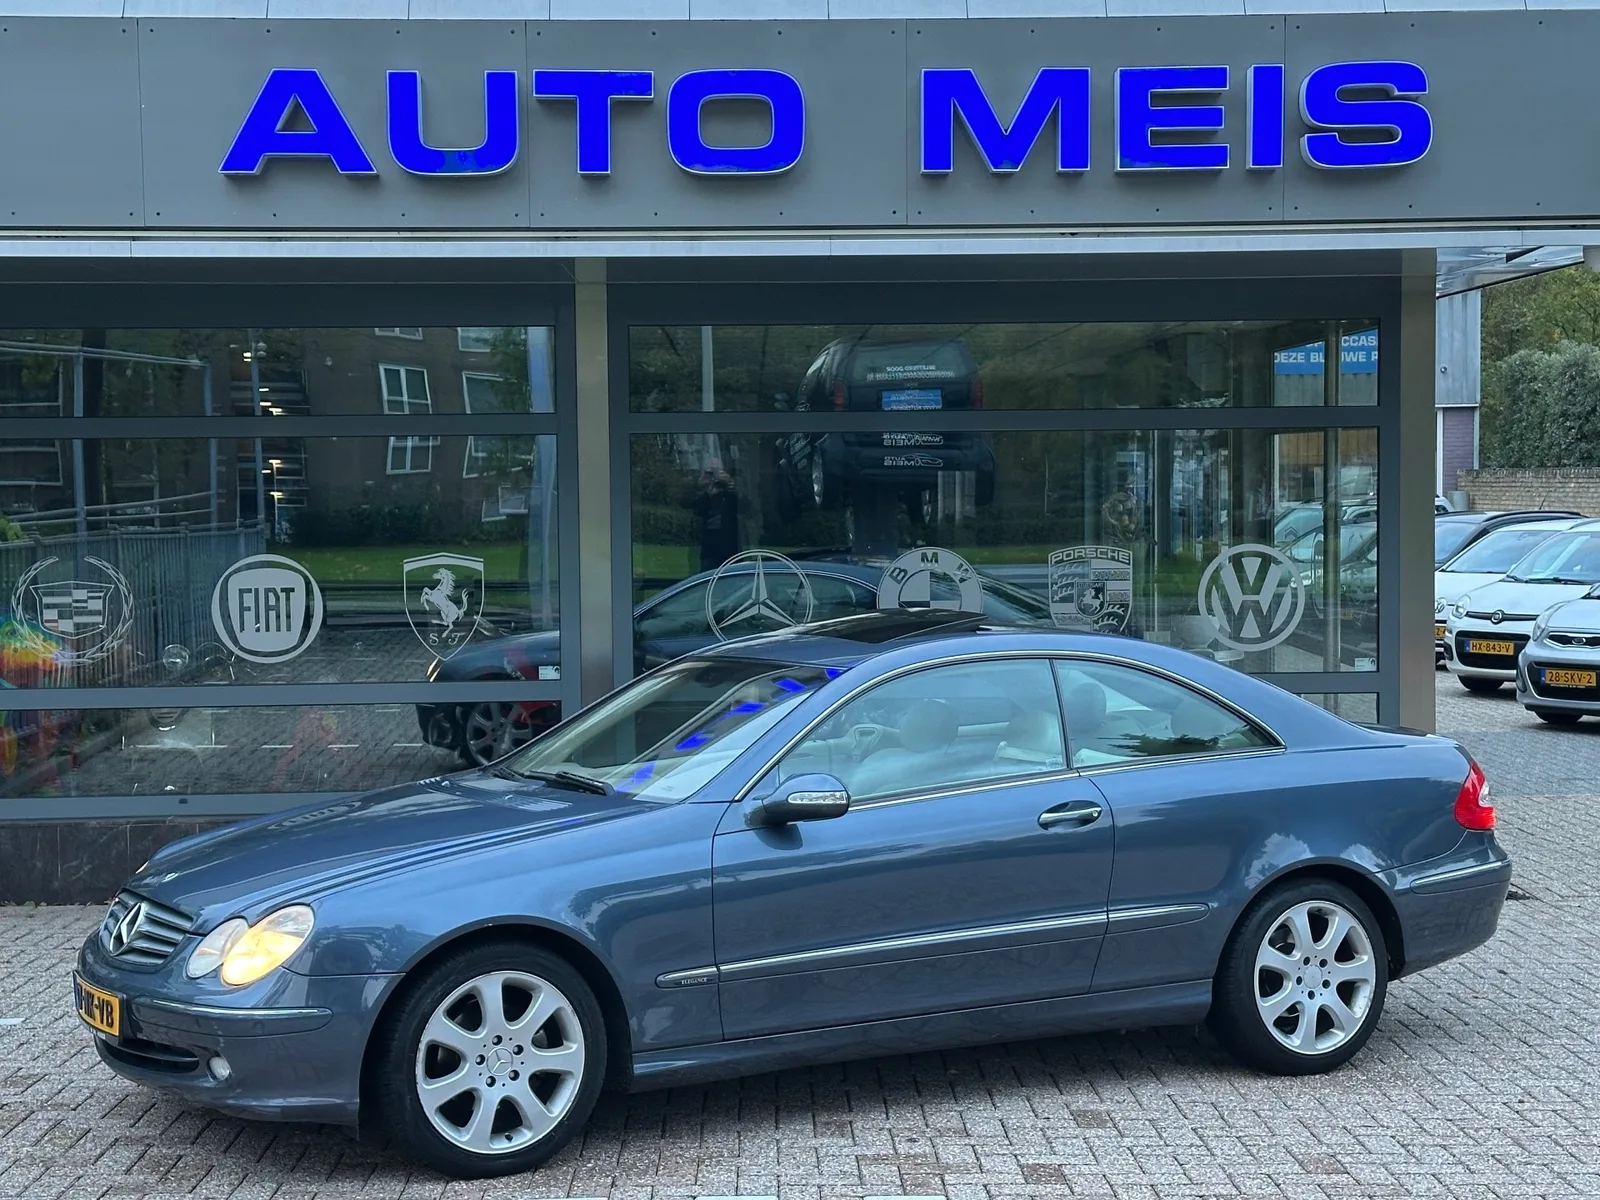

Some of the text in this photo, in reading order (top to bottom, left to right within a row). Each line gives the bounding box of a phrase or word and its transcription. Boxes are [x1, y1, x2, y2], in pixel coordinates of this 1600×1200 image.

[218, 60, 1434, 177] AUTO MEIS
[1051, 548, 1130, 565] PORSCHE
[237, 587, 295, 633] FIAT
[1471, 640, 1511, 654] HX-843-V
[1548, 671, 1593, 684] 28-SKV-2
[681, 977, 708, 985] ELEGANCE
